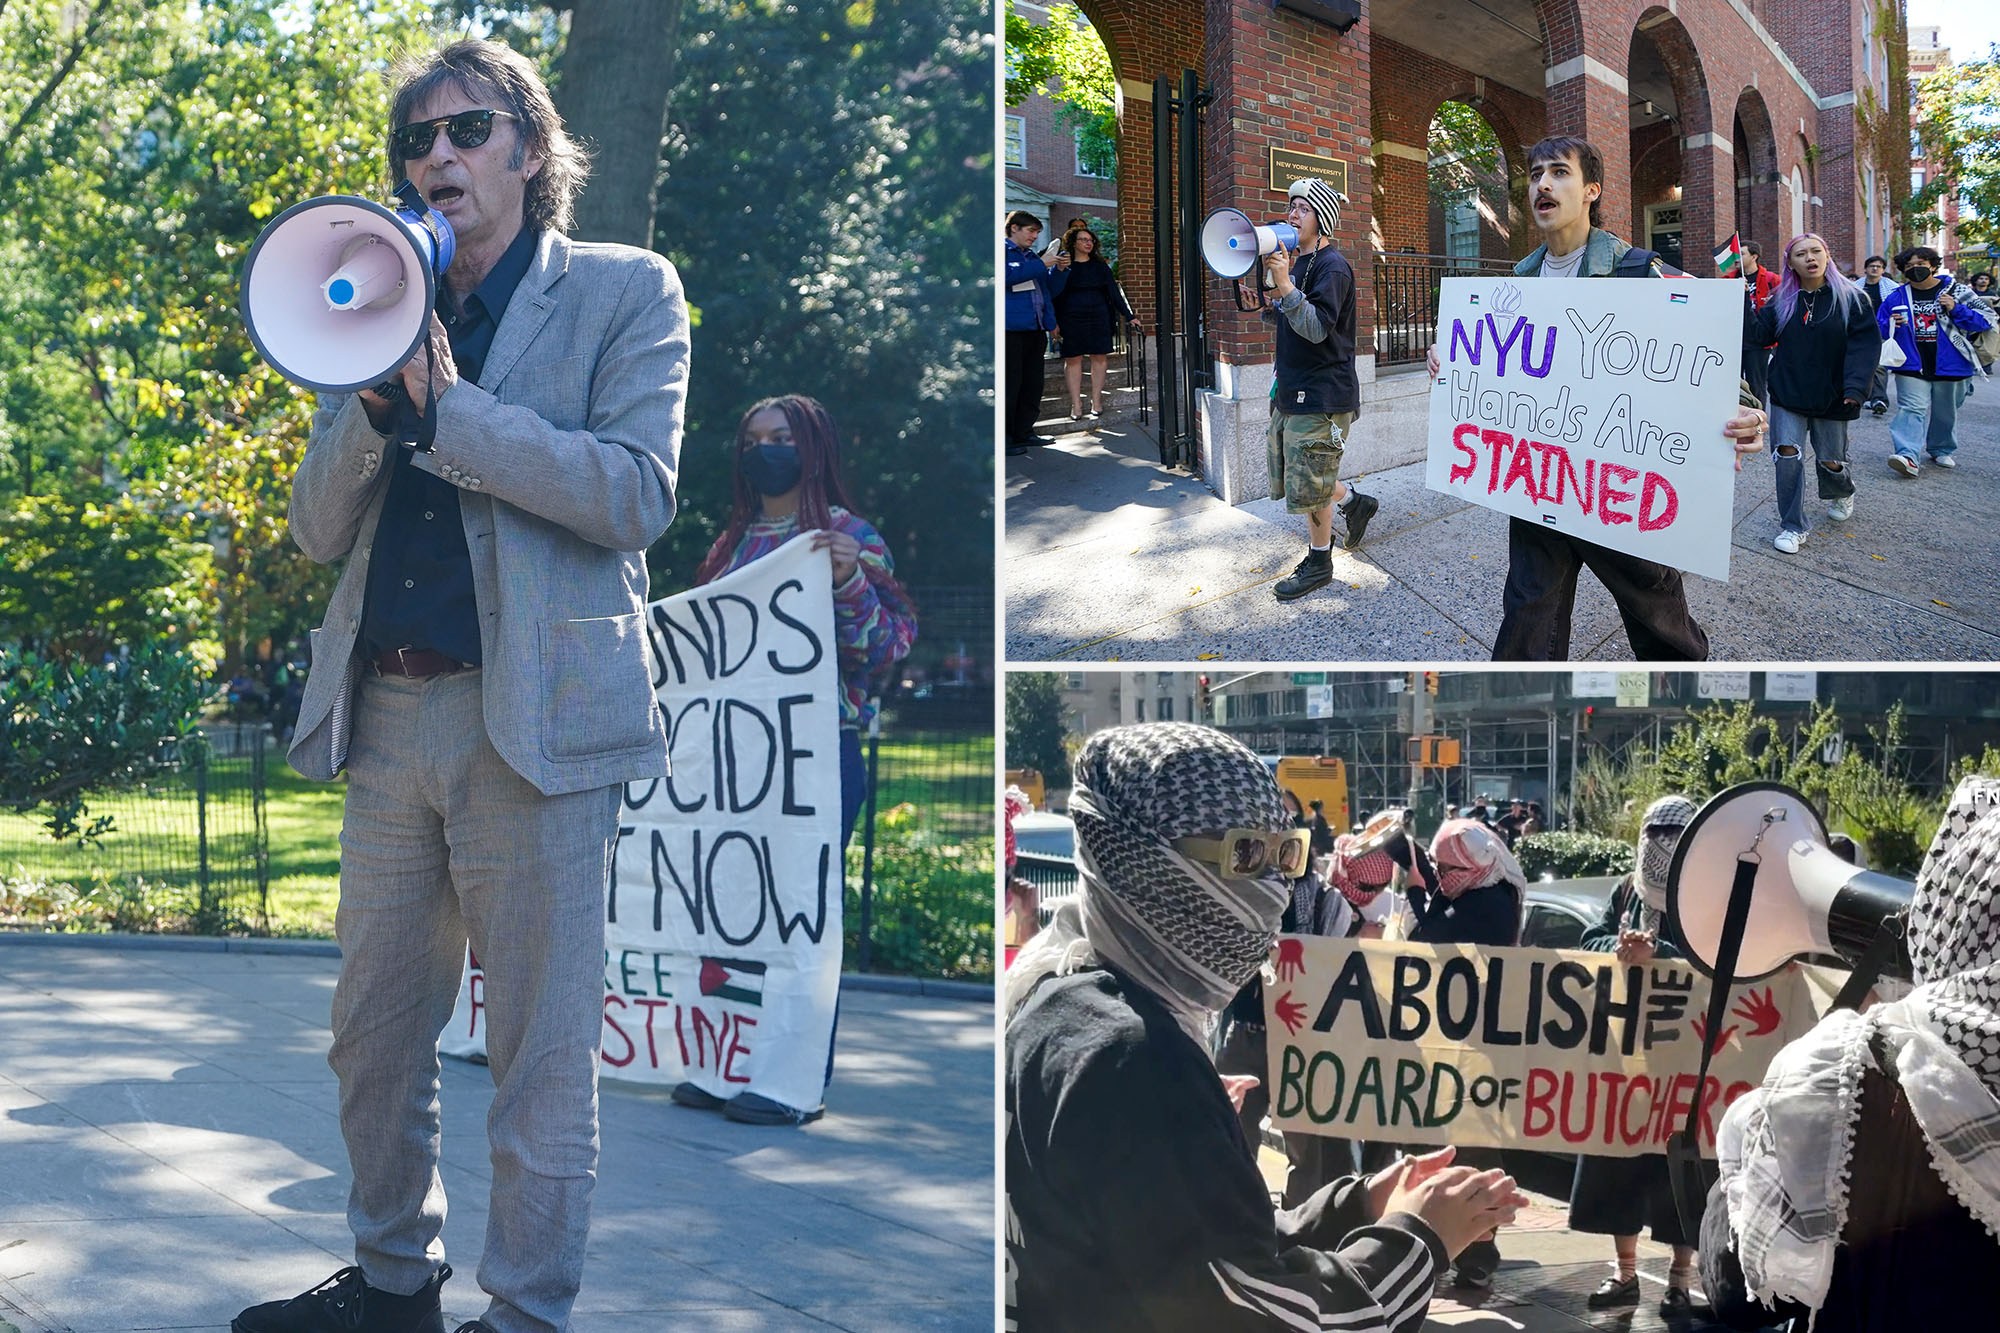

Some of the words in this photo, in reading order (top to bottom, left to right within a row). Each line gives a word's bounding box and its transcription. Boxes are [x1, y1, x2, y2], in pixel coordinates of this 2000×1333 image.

[1276, 160, 1292, 169] NEW
[1292, 163, 1309, 172] YORK
[1309, 166, 1342, 177] UNIVERSITY
[1450, 313, 1557, 378] NYU
[1450, 369, 1588, 443] Hands
[1594, 393, 1691, 465] Are
[1450, 423, 1680, 533] STAINED
[652, 830, 830, 947] NOW
[604, 949, 674, 998] EE
[1312, 951, 1643, 1056] ABOLISH
[1643, 967, 1693, 1051] THE
[1276, 1044, 1464, 1129] BOARD
[1469, 1075, 1522, 1113] OF
